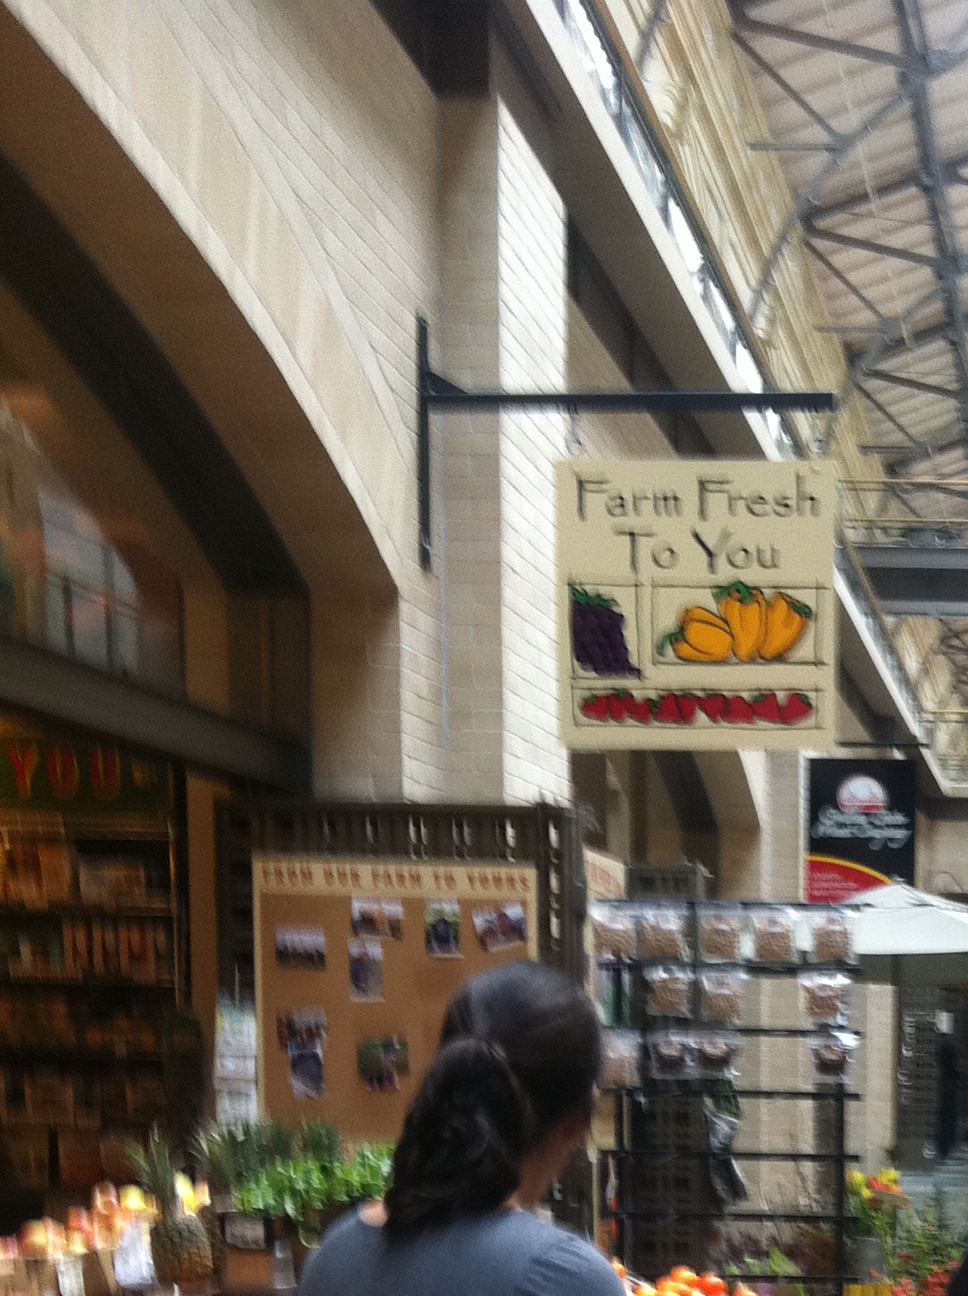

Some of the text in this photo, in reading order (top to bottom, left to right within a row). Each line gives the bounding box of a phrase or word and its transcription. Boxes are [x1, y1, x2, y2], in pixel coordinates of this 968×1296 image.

[574, 470, 821, 523] Farm Fresh
[611, 526, 781, 576] To You
